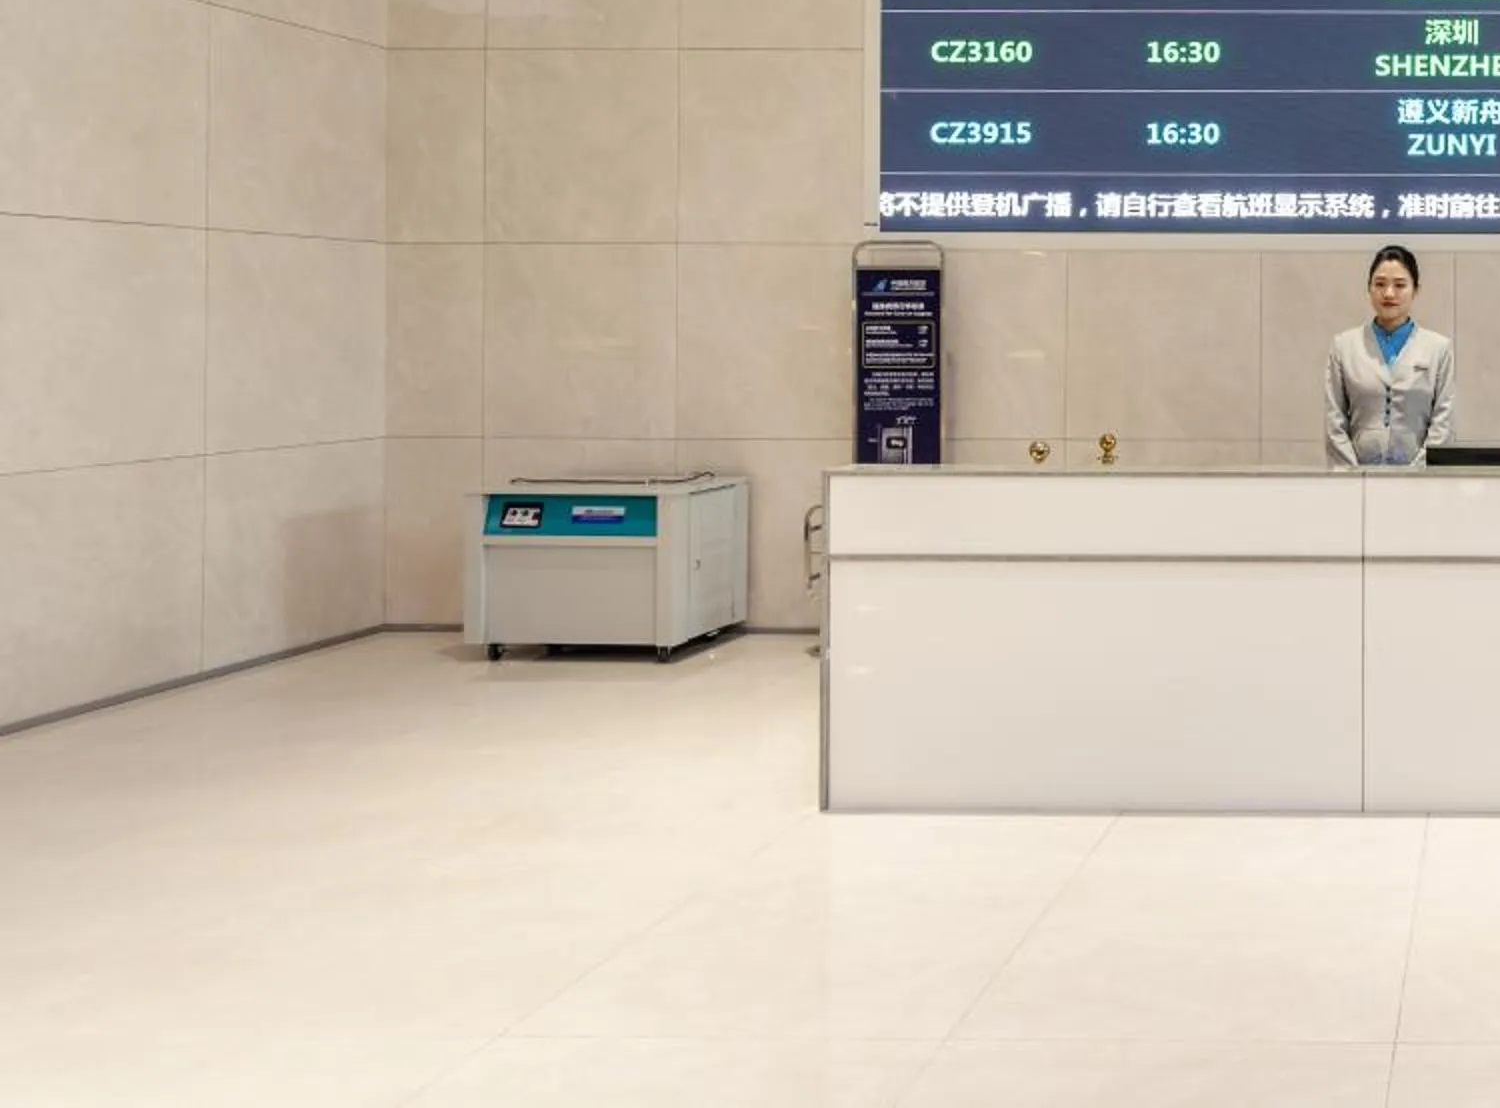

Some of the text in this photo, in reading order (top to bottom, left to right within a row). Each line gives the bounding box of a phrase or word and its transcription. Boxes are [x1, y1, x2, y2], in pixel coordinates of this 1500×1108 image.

[1425, 19, 1479, 45] 深圳
[931, 40, 1033, 63] CZ3160
[1147, 41, 1221, 63] 16:30
[930, 121, 1032, 144] CZ3915
[1147, 122, 1220, 145] 16:30
[1407, 133, 1497, 156] ZUNYI
